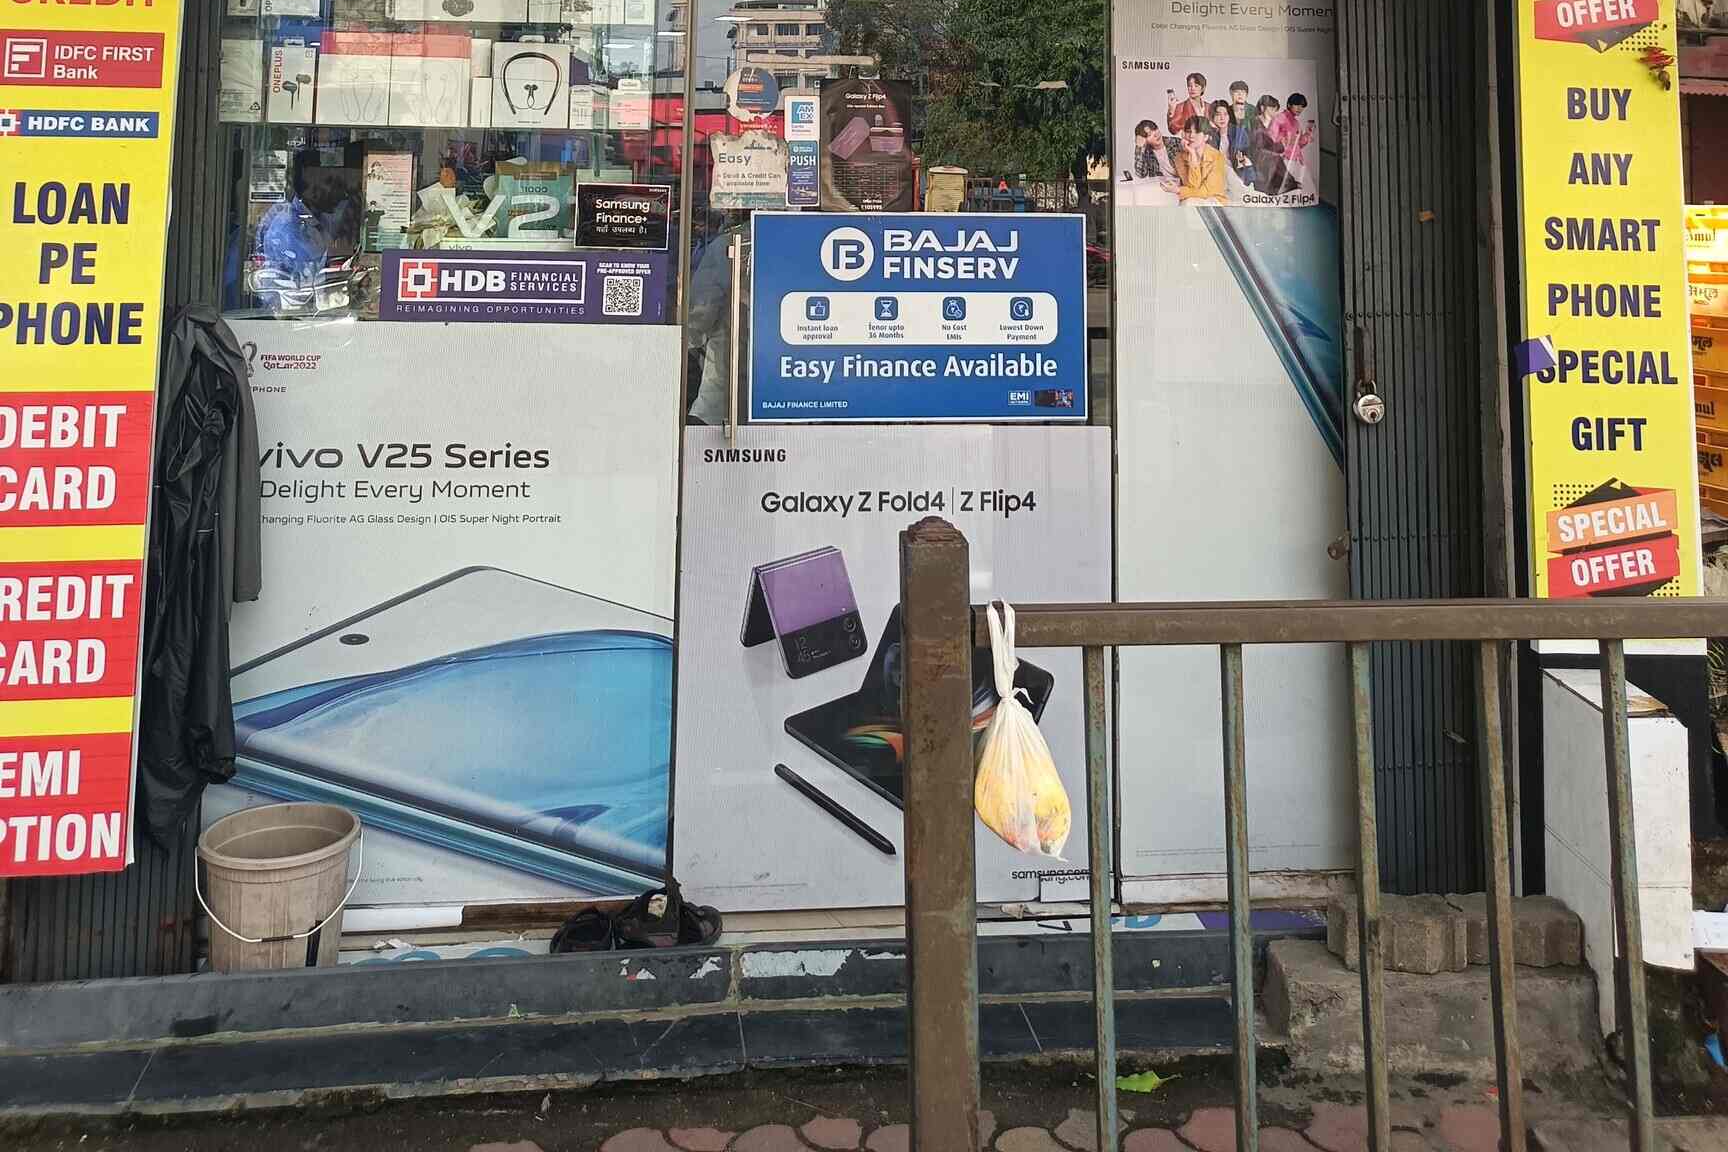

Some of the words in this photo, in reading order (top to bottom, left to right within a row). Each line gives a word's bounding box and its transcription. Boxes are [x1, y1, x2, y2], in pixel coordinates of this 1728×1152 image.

[1170, 1, 1225, 18] Delight
[1230, 3, 1274, 19] Every
[1279, 4, 1335, 18] Momen
[54, 44, 97, 61] IDFC
[102, 46, 155, 63] FIRST
[53, 64, 99, 80] Bank
[272, 49, 285, 94] ONEPLUS
[1121, 60, 1171, 71] SAMSUNG
[1566, 86, 1633, 122] BUY
[27, 115, 85, 132] HDFC
[90, 116, 150, 133] BANK
[718, 152, 752, 166] Easy
[790, 155, 817, 166] PUSH
[1567, 152, 1634, 186] ANY
[12, 180, 131, 225] LOAN
[595, 199, 651, 213] Samsung
[1242, 193, 1281, 206] Galaxy
[1282, 194, 1290, 205] Z
[1291, 193, 1315, 206] Flip4
[595, 212, 648, 224] Finance+
[883, 229, 1019, 253] BAJAJ
[1544, 216, 1662, 252] SMART
[38, 241, 98, 285] PE
[883, 256, 1020, 280] FINSERV
[440, 270, 506, 292] HDB
[511, 272, 579, 283] FINANCIAL
[510, 282, 578, 293] SERVICES
[396, 304, 480, 314] REIMAGINING
[487, 305, 586, 316] OPPORTUNITIES
[1547, 283, 1663, 319] PHONE
[797, 324, 821, 332] Instant
[803, 332, 833, 341] approval
[879, 331, 904, 339] Months
[889, 323, 905, 333] upto
[946, 333, 962, 341] EMIs
[1007, 333, 1037, 342] Payment
[780, 355, 835, 384] Easy
[843, 354, 937, 378] Finance
[944, 353, 1058, 378] Available
[762, 401, 786, 409] BAJAJ
[787, 400, 819, 409] FINANCE
[820, 400, 848, 409] LIMITED
[1009, 392, 1029, 401] EMI
[1570, 416, 1648, 452] GIFT
[357, 443, 432, 469] V25
[444, 441, 550, 470] Series
[703, 448, 787, 463] SAMSUNG
[260, 479, 346, 504] Delight
[354, 480, 424, 504] Every
[432, 480, 531, 499] Moment
[761, 490, 854, 518] Galaxy
[857, 491, 872, 513] Z
[878, 490, 946, 513] Fold4
[960, 491, 974, 512] Z
[979, 489, 1037, 518] Flip4
[261, 514, 304, 526] hanging
[306, 514, 347, 524] Fluorite
[349, 515, 365, 524] AG
[367, 514, 394, 524] Glass
[397, 514, 432, 527] Design
[439, 514, 457, 524] OIS
[459, 514, 490, 527] Super
[492, 514, 520, 527] Night
[522, 514, 561, 524] Portrait
[1556, 500, 1667, 544] SPECIAL
[1570, 548, 1657, 587] OFFER
[0, 574, 135, 623] REDIT
[0, 637, 108, 687] ARD
[0, 811, 123, 864] TION
